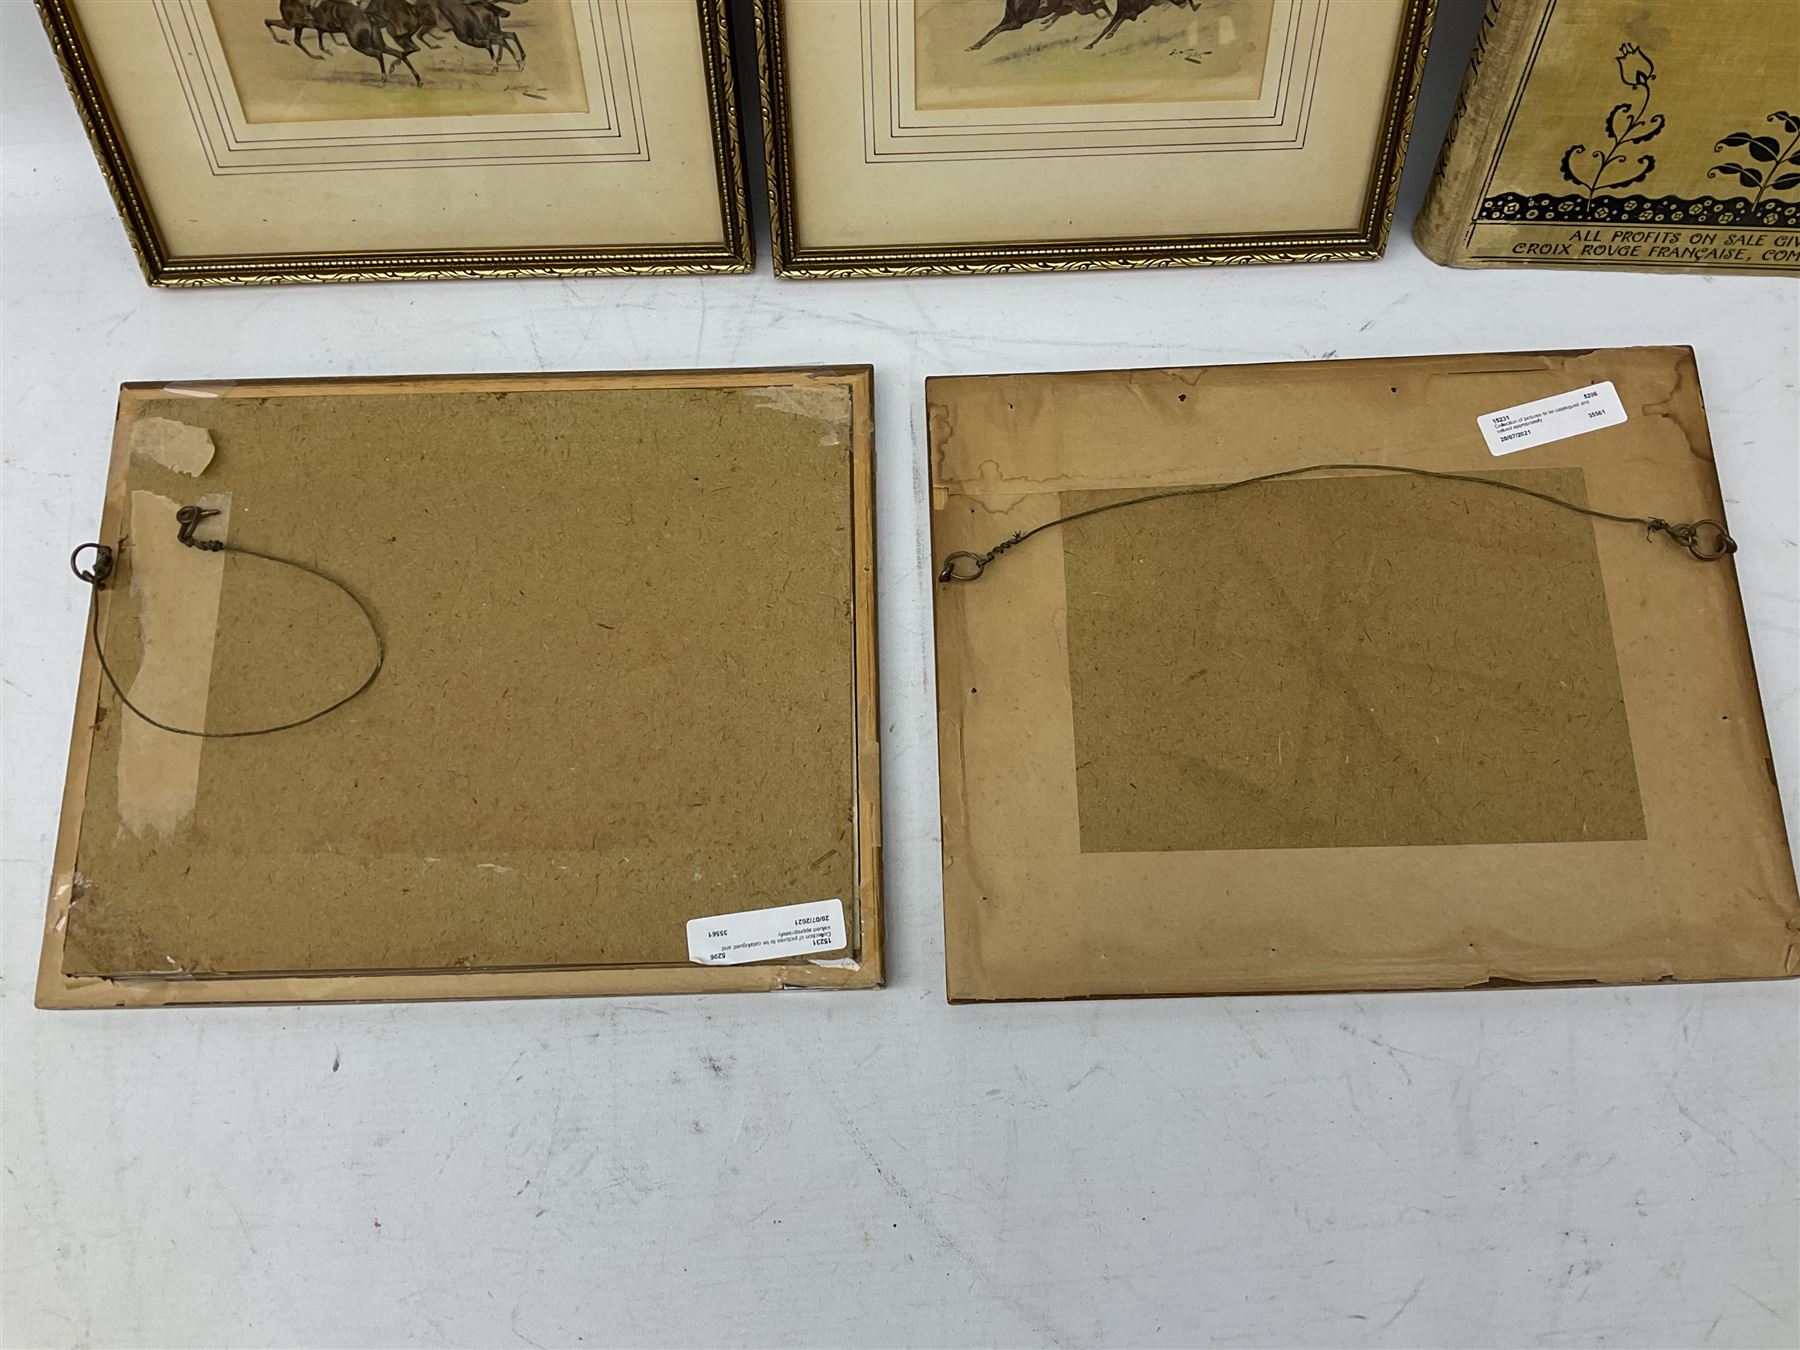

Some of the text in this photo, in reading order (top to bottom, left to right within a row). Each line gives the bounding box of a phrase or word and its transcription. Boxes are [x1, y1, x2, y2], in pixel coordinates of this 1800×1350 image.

[1569, 230, 1602, 242] ALL
[1611, 231, 1682, 244] PROFITS
[1689, 233, 1718, 245] ON
[1723, 234, 1768, 247] SALE
[1512, 243, 1573, 255] CROIX
[1648, 246, 1752, 262] FRANÇAISE,
[1492, 415, 1510, 424] 15231
[1494, 420, 1518, 429] Collection
[806, 931, 832, 939] Collection
[813, 937, 832, 946] 15231
[710, 952, 726, 960] 5206
